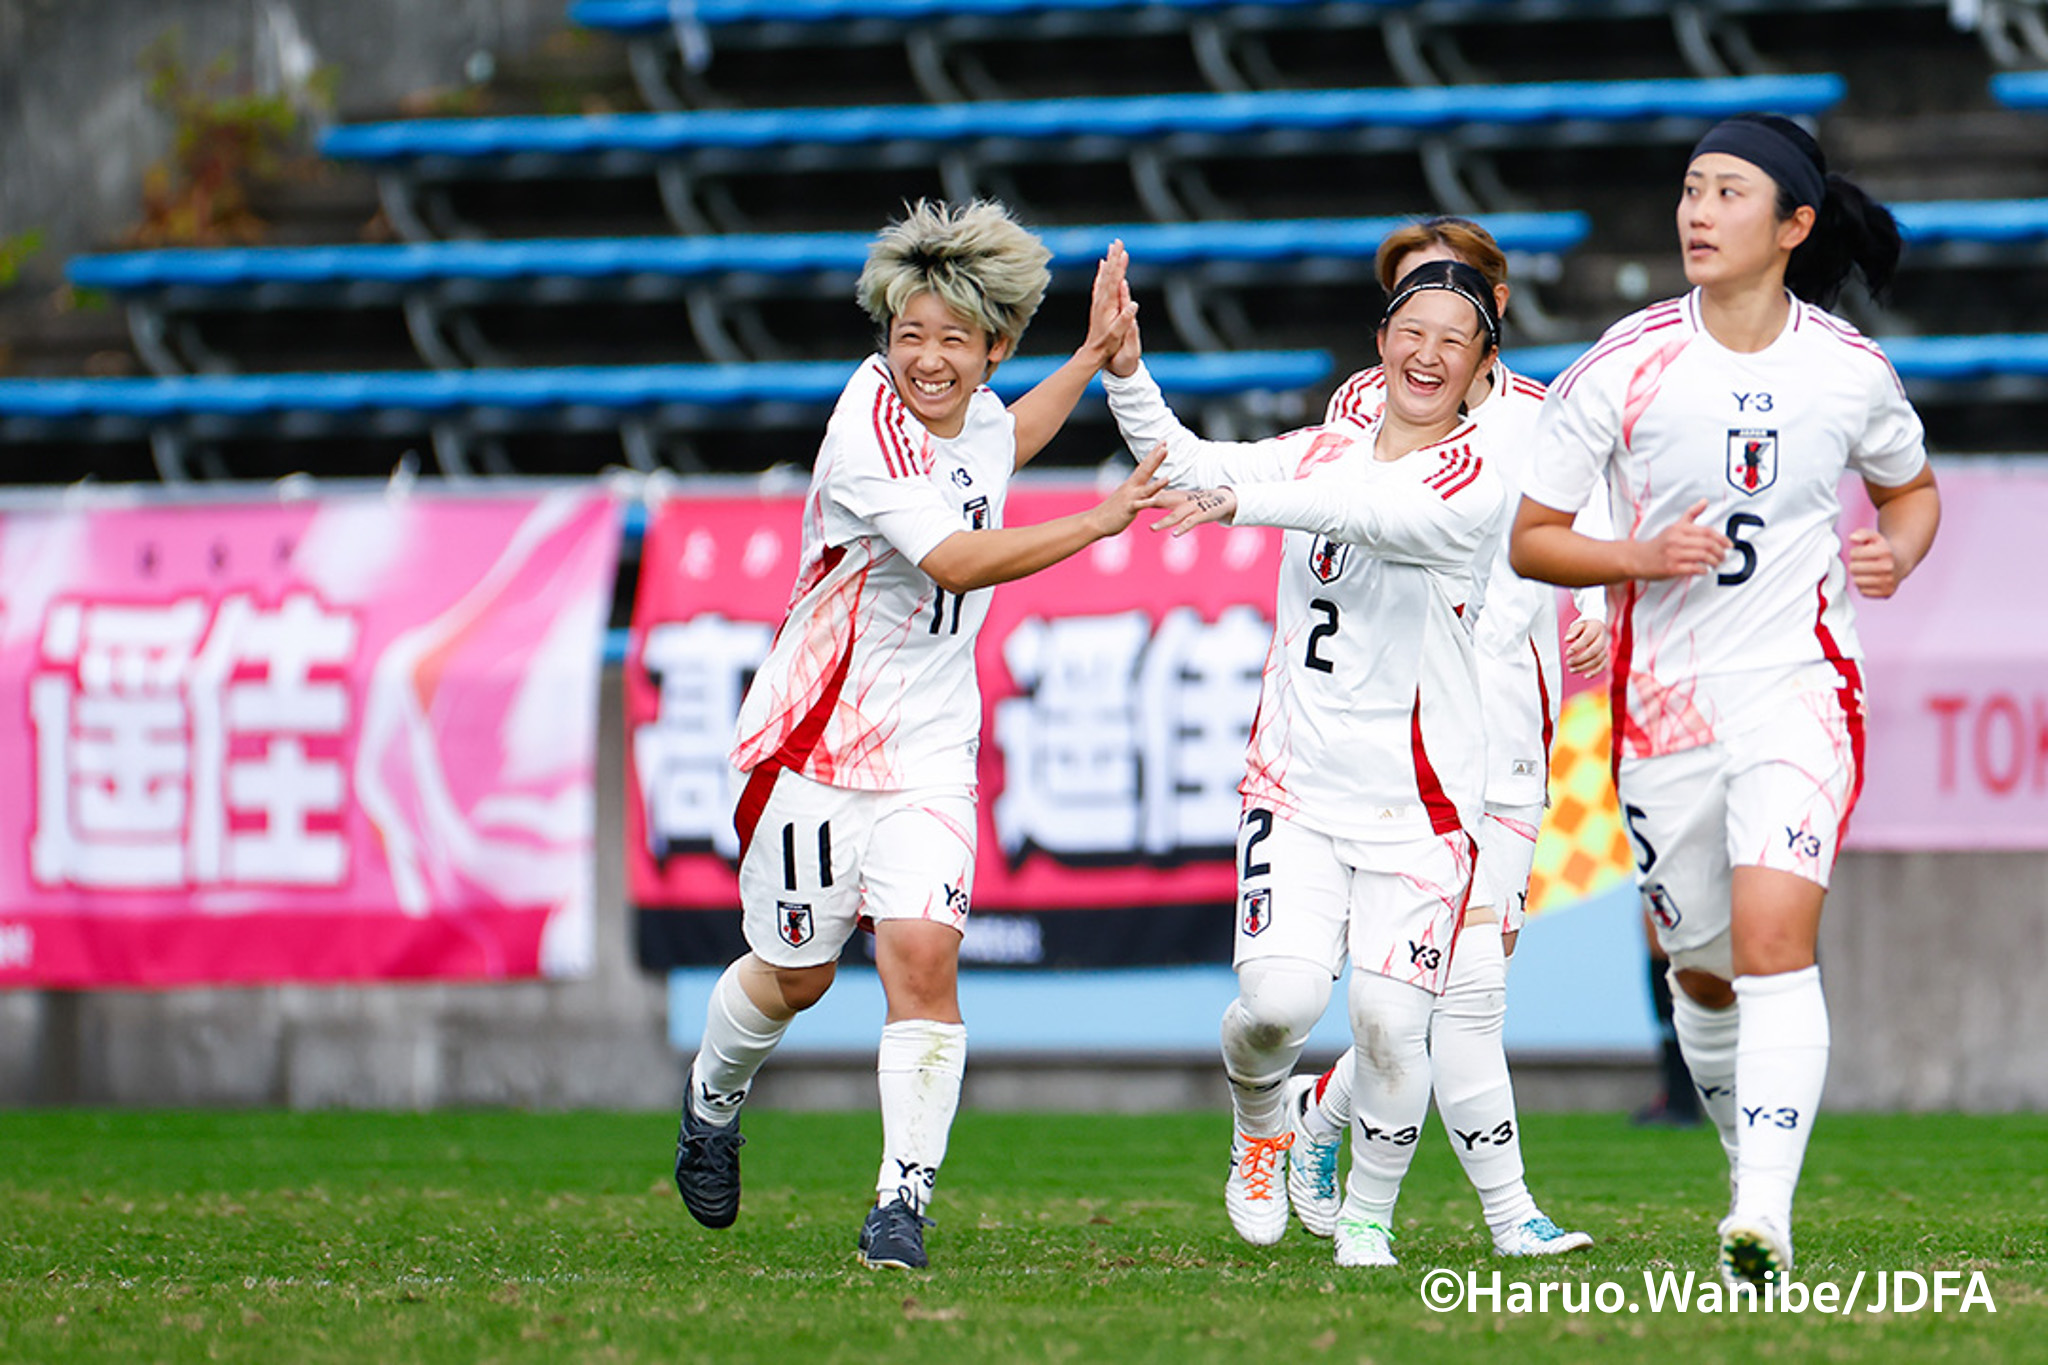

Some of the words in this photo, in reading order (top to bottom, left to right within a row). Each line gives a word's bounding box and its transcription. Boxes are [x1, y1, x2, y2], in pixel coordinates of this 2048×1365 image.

[1732, 391, 1774, 413] Y-3
[1717, 512, 1766, 586] 5
[1305, 598, 1339, 674] 2
[782, 820, 834, 892] 11
[1244, 808, 1274, 881] 2
[1786, 826, 1821, 858] Y-3
[943, 883, 968, 914] Y-3
[1408, 940, 1442, 970] Y-3
[1359, 1117, 1419, 1146] Y-3
[1742, 1106, 1799, 1130] Y-3
[1453, 1120, 1514, 1151] Y-3
[896, 1158, 936, 1189] Y-3
